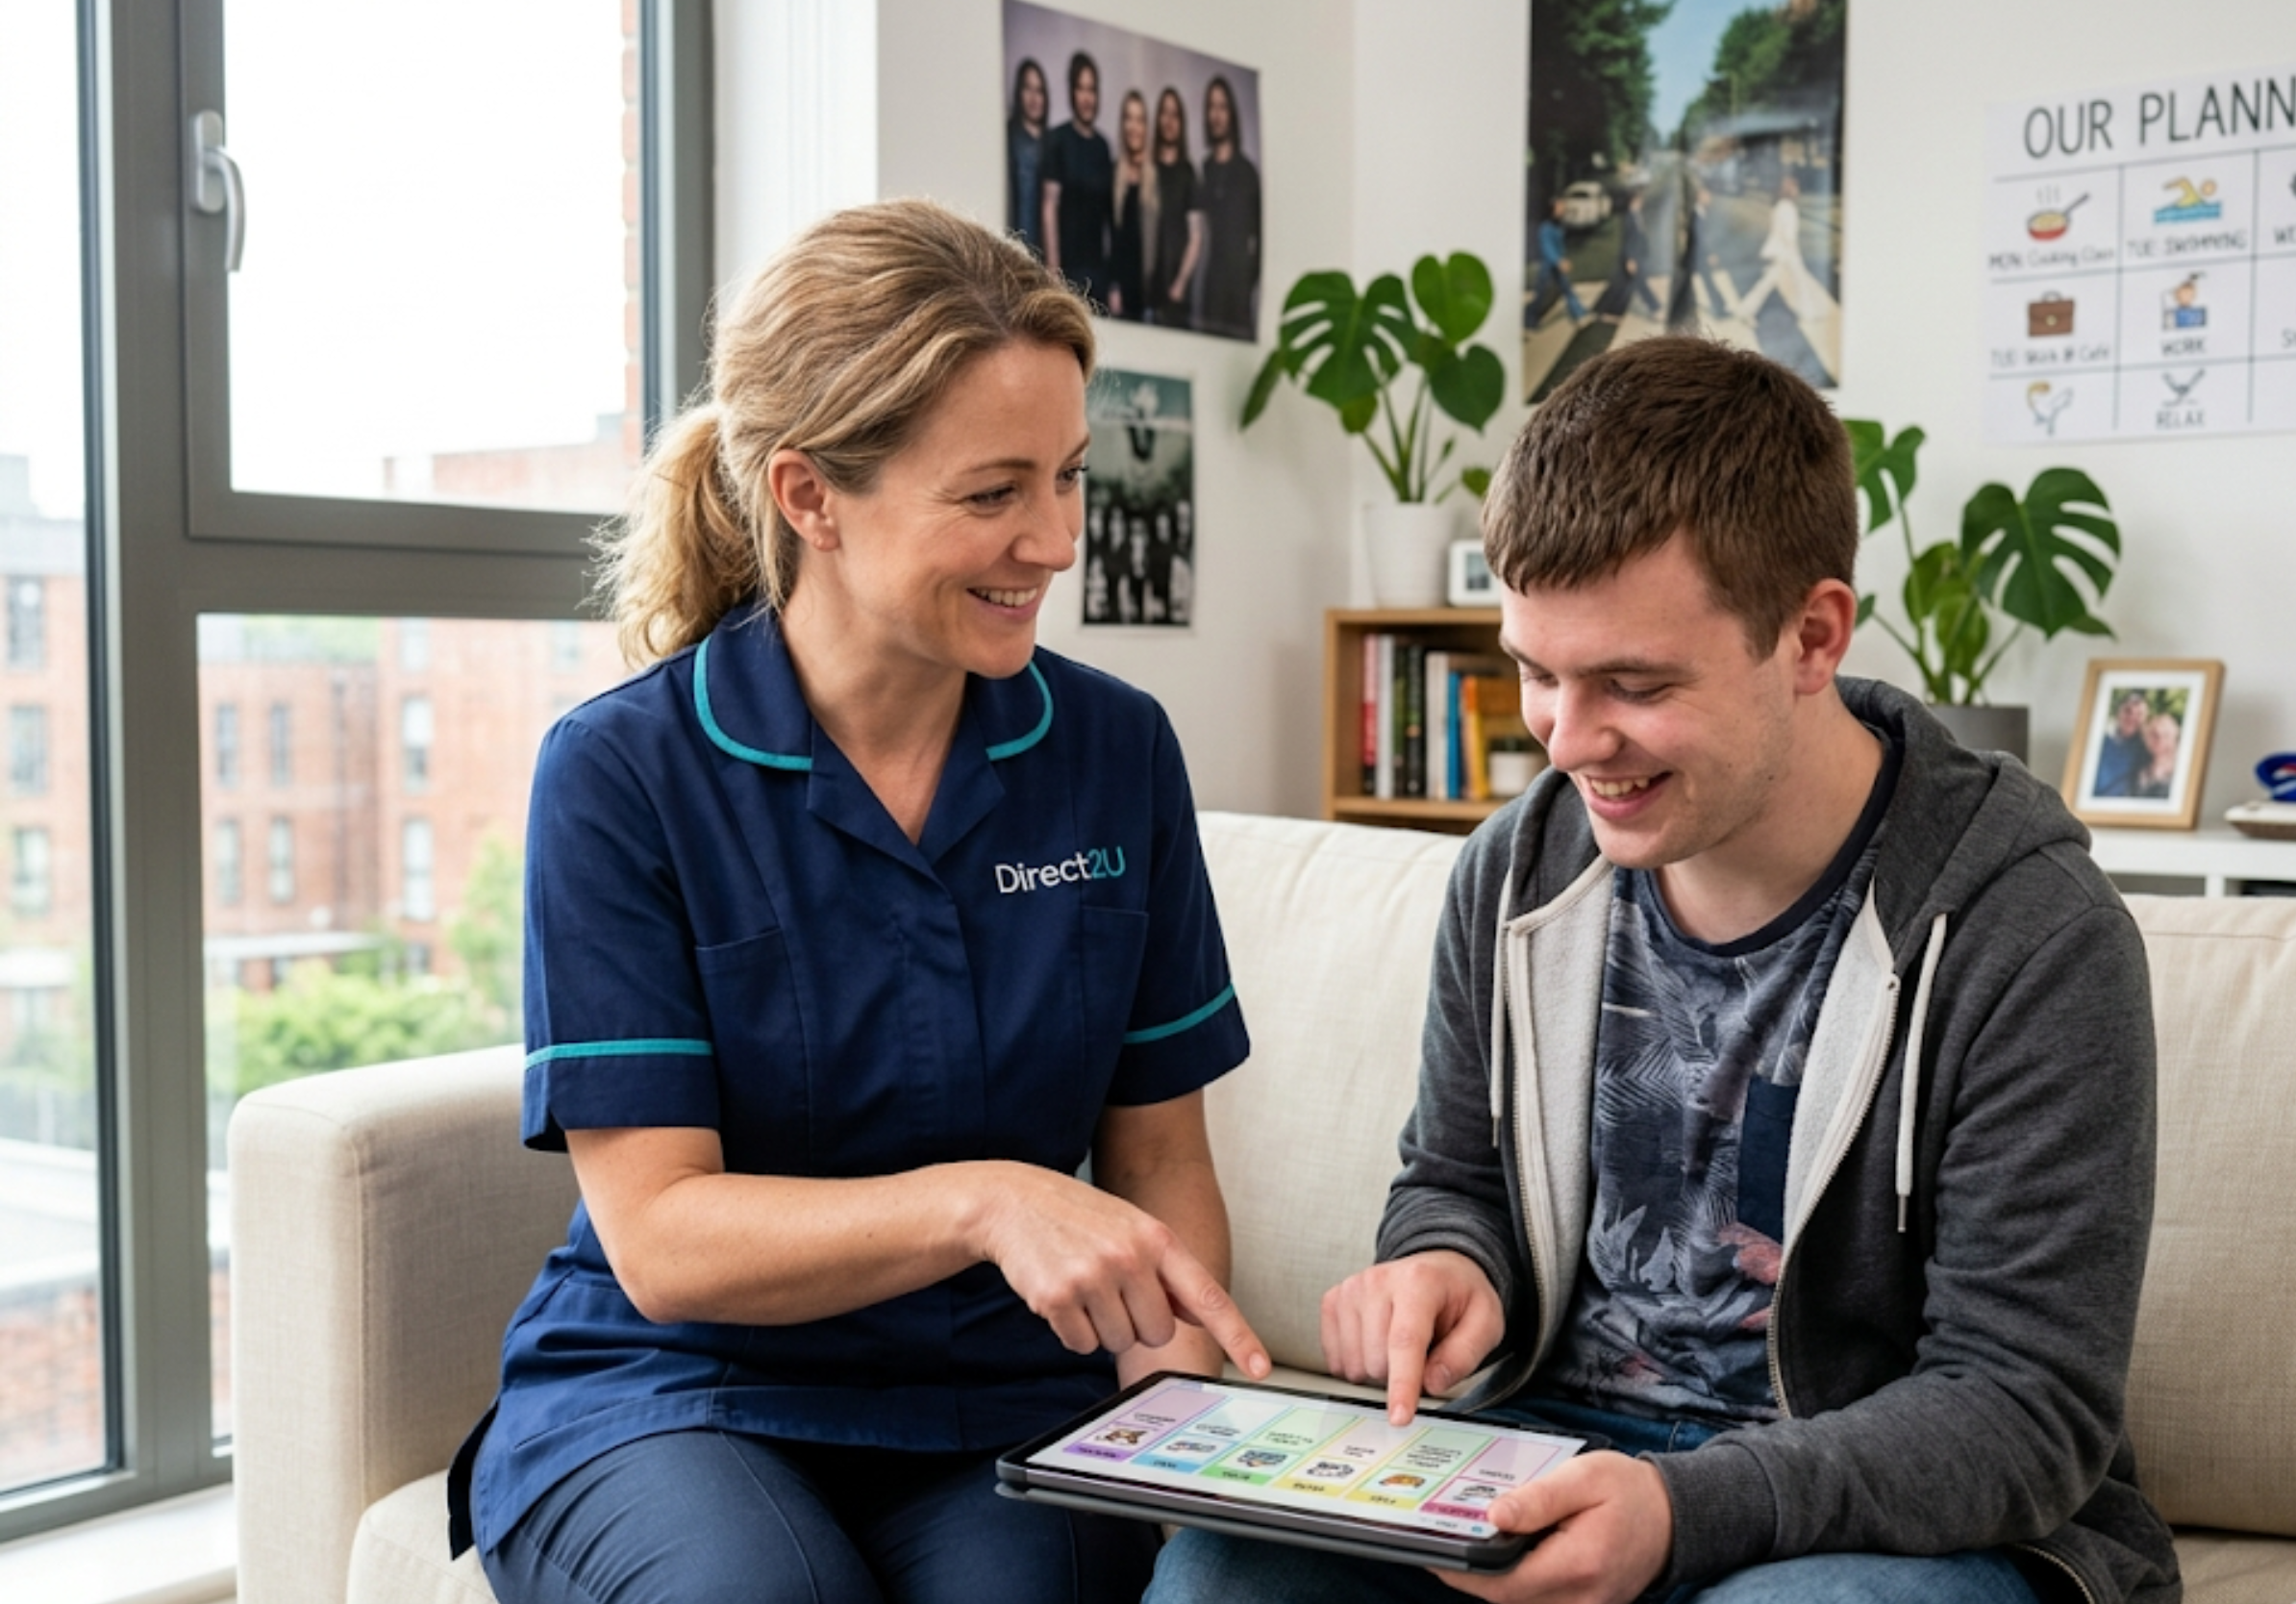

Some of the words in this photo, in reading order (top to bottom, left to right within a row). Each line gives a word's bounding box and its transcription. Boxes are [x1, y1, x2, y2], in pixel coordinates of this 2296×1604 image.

[2024, 99, 2113, 160] OUR
[2161, 336, 2207, 357] WORK
[2156, 408, 2206, 431] RELAX
[994, 845, 1126, 893] Direct2U
